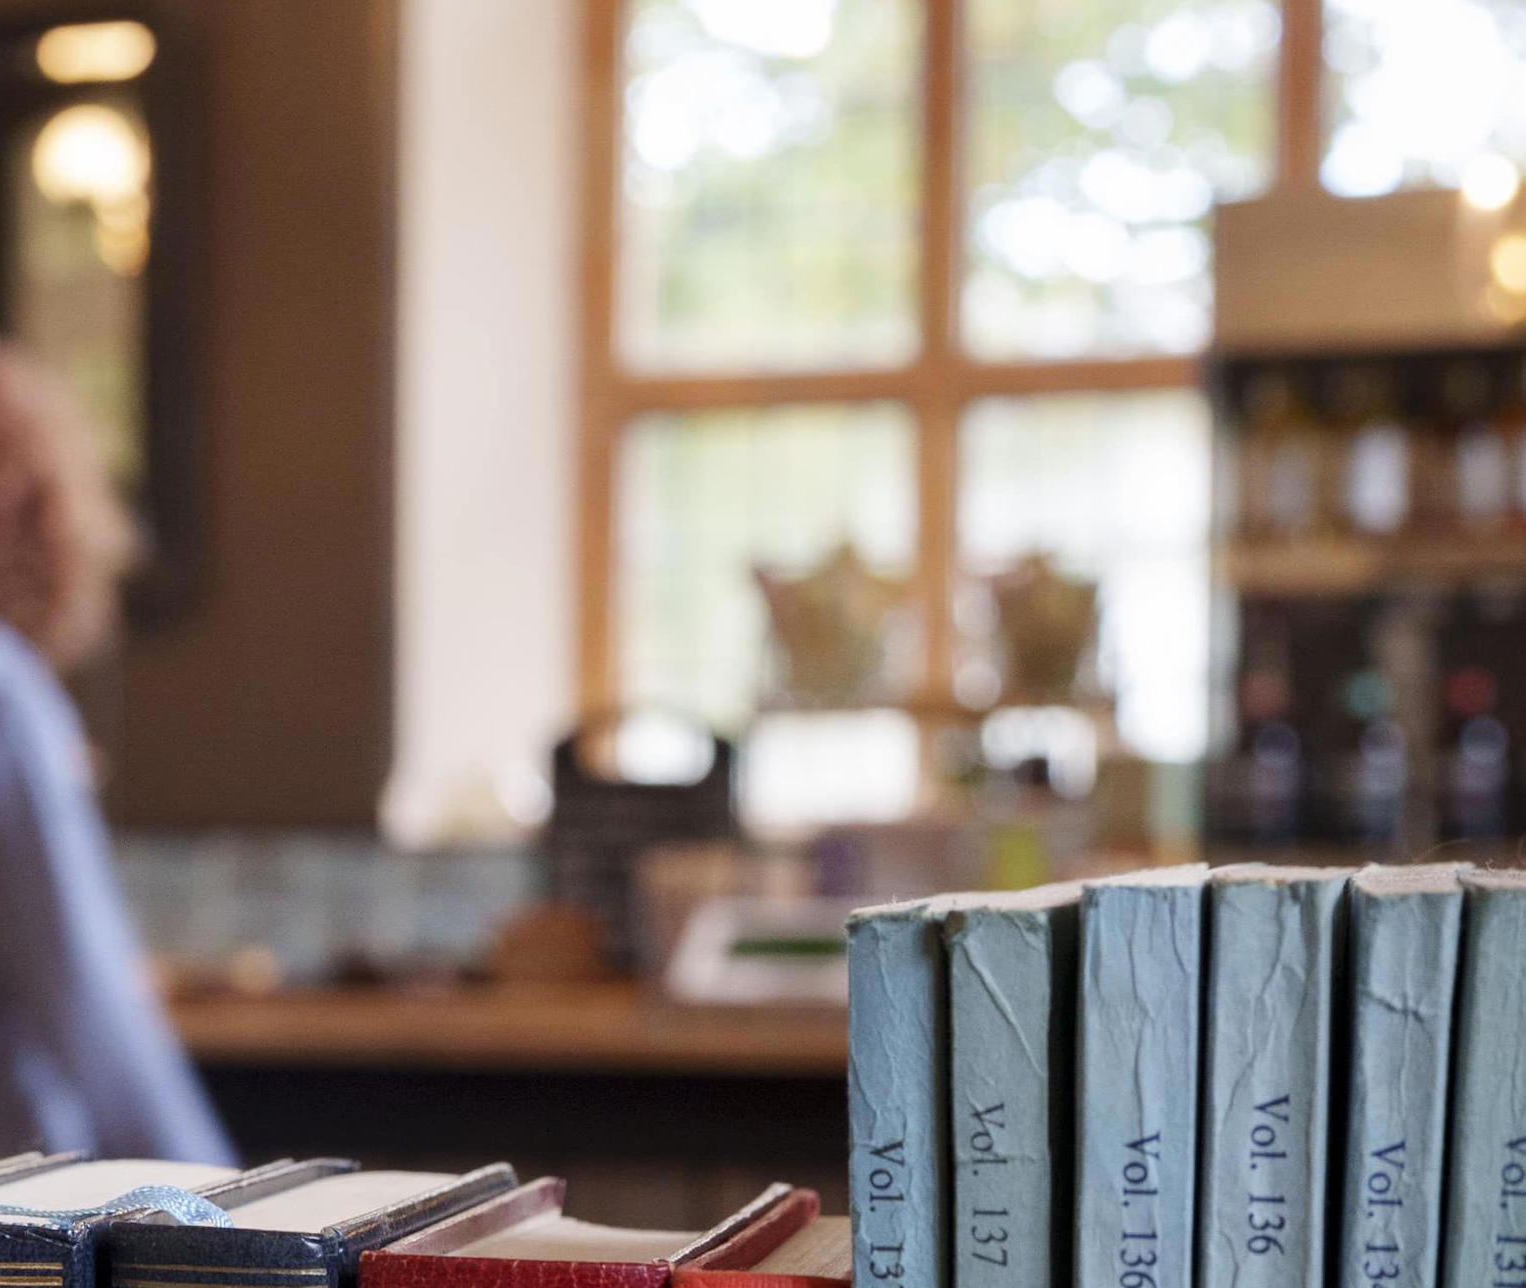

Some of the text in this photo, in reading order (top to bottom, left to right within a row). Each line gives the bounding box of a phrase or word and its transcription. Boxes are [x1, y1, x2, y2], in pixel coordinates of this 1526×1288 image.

[970, 1102, 1006, 1177] Vol.
[1120, 1131, 1161, 1208] Vol.
[1249, 1095, 1291, 1171] Vol.
[867, 1139, 905, 1213] Vol.
[1365, 1139, 1406, 1219] Vol.
[972, 1205, 1009, 1268] 137
[1246, 1193, 1286, 1256] 136
